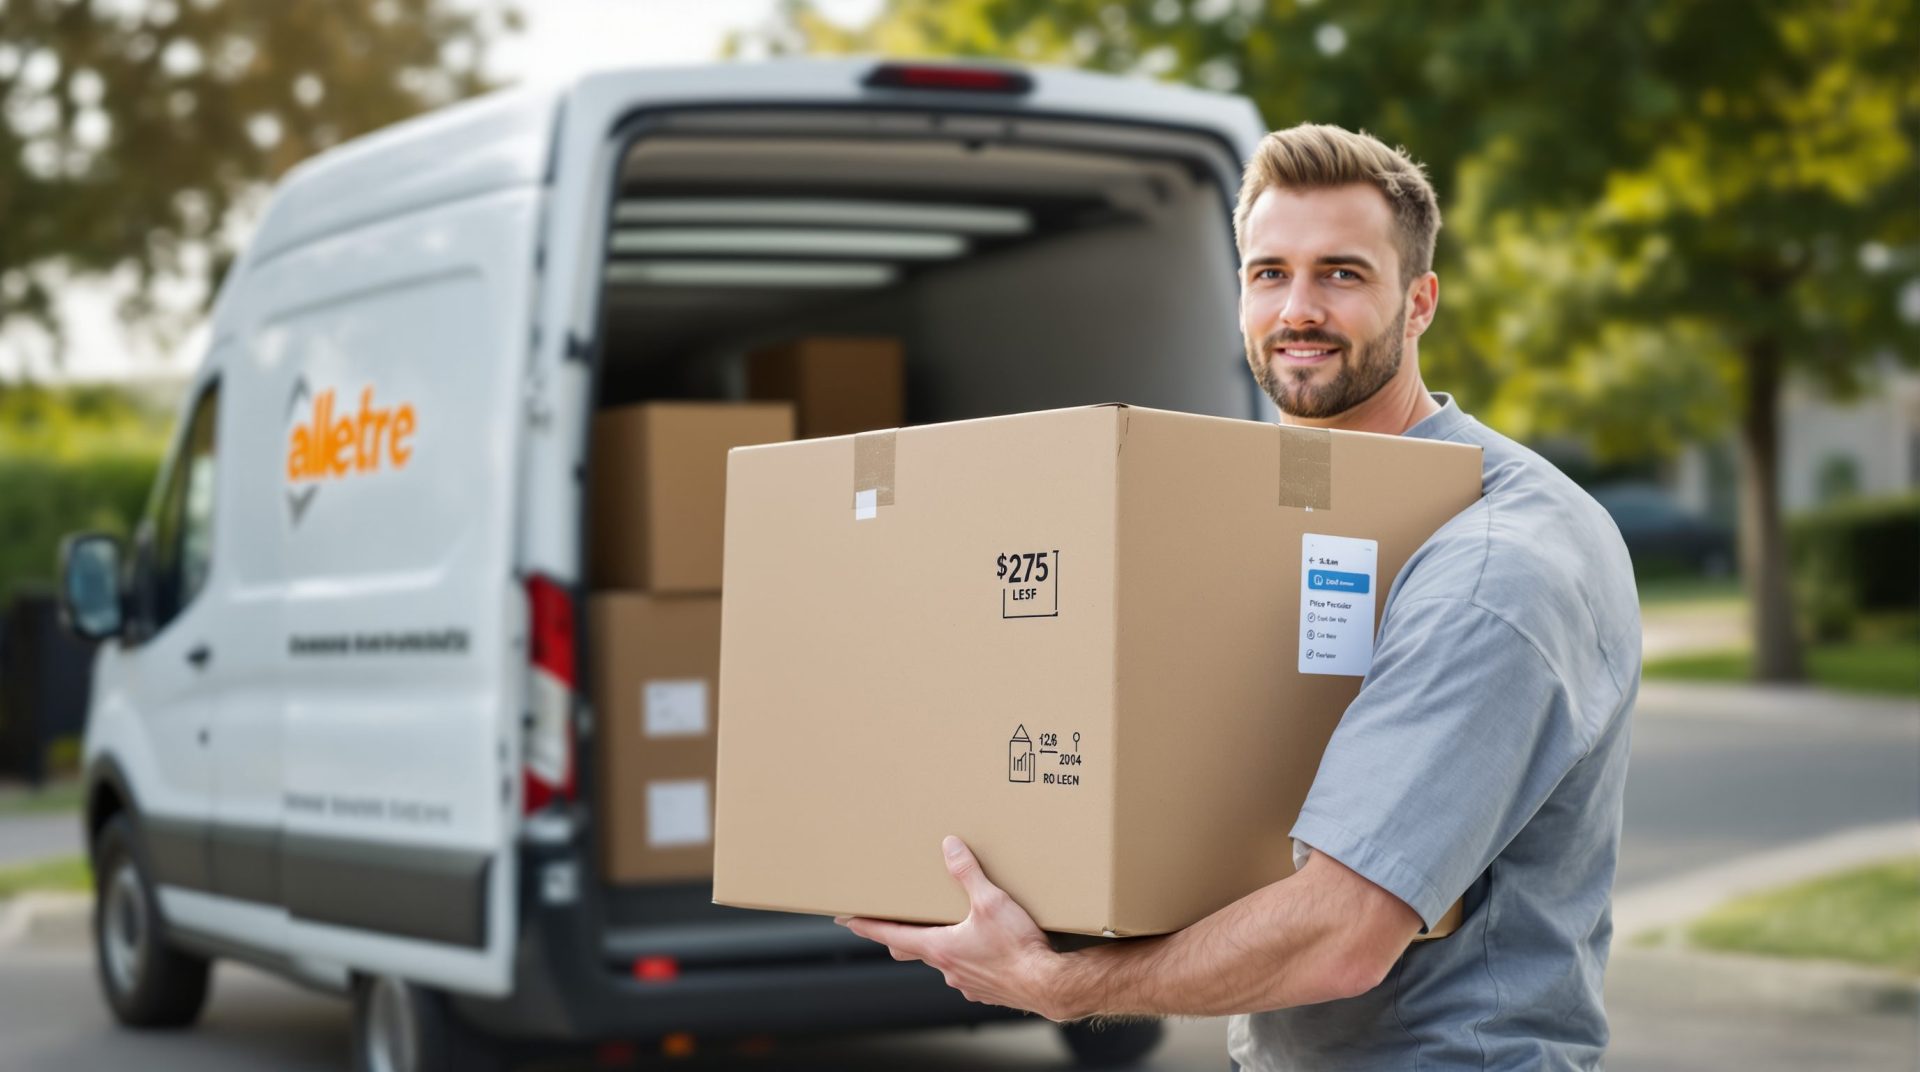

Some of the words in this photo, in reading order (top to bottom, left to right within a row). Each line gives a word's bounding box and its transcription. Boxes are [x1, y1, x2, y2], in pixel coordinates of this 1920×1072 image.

[288, 385, 416, 480] alletre
[997, 553, 1048, 583] $275
[1013, 588, 1037, 600] LESF
